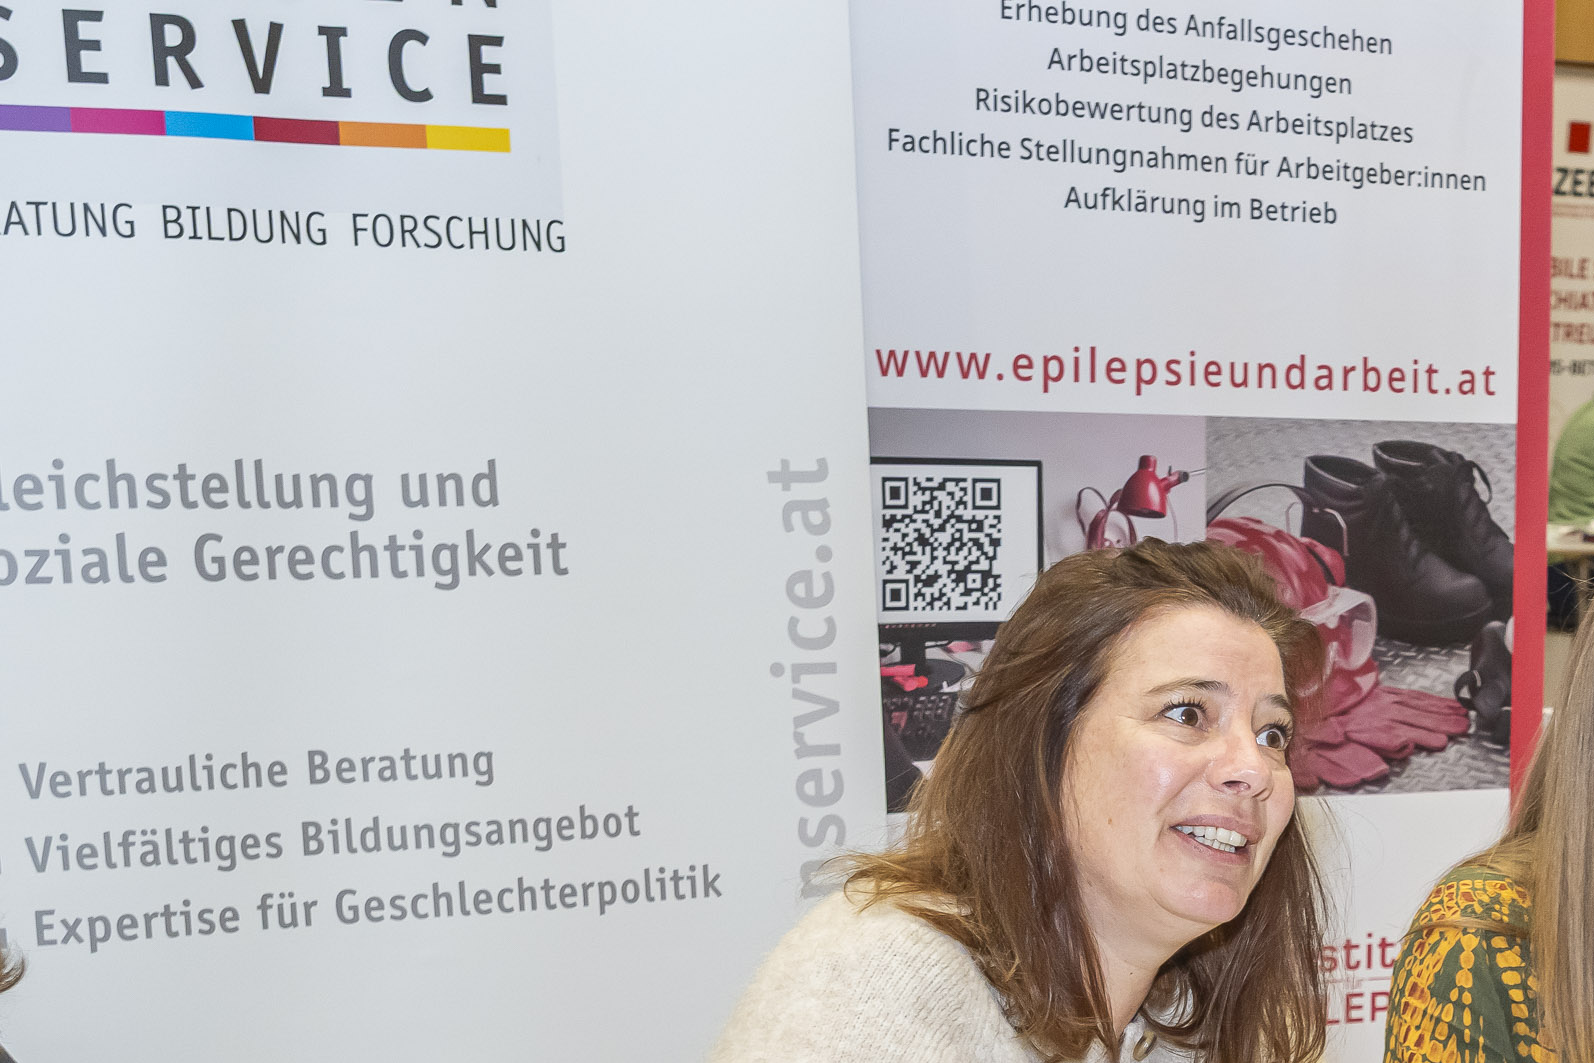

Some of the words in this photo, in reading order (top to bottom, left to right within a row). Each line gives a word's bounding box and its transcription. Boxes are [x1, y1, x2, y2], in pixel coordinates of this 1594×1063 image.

[1000, 0, 1127, 36] Erhebung
[1136, 8, 1178, 34] des
[1184, 14, 1393, 55] Anfallsgeschehen
[1047, 47, 1352, 98] Arbeitsplatzbegehungen
[975, 87, 1193, 133] Risikobewertung
[1201, 104, 1240, 130] des
[1246, 109, 1414, 144] Arbeitsplatzes
[888, 127, 1011, 160] Fachliche
[1019, 137, 1227, 174] Stellungnahmen
[1235, 151, 1269, 176] für
[1276, 155, 1487, 191] Arbeitgeber:innen
[161, 203, 329, 246] BILDUNG
[352, 213, 566, 253] FORSCHUNG
[1064, 186, 1206, 222] Aufklärung
[1213, 194, 1241, 219] im
[1250, 198, 1338, 224] Betrieb
[874, 345, 1497, 396] www.epilepsieundarbeit.at
[400, 457, 500, 508] und
[194, 527, 569, 590] Gerechtigkeit
[18, 752, 289, 800] Vertrauliche
[306, 747, 496, 787] Beratung
[24, 825, 284, 873] Vielfältiges
[301, 804, 642, 858] Bildungsangebot
[34, 899, 240, 953] Expertise
[256, 891, 319, 930] für
[335, 863, 724, 925] Geschlechterpolitik
